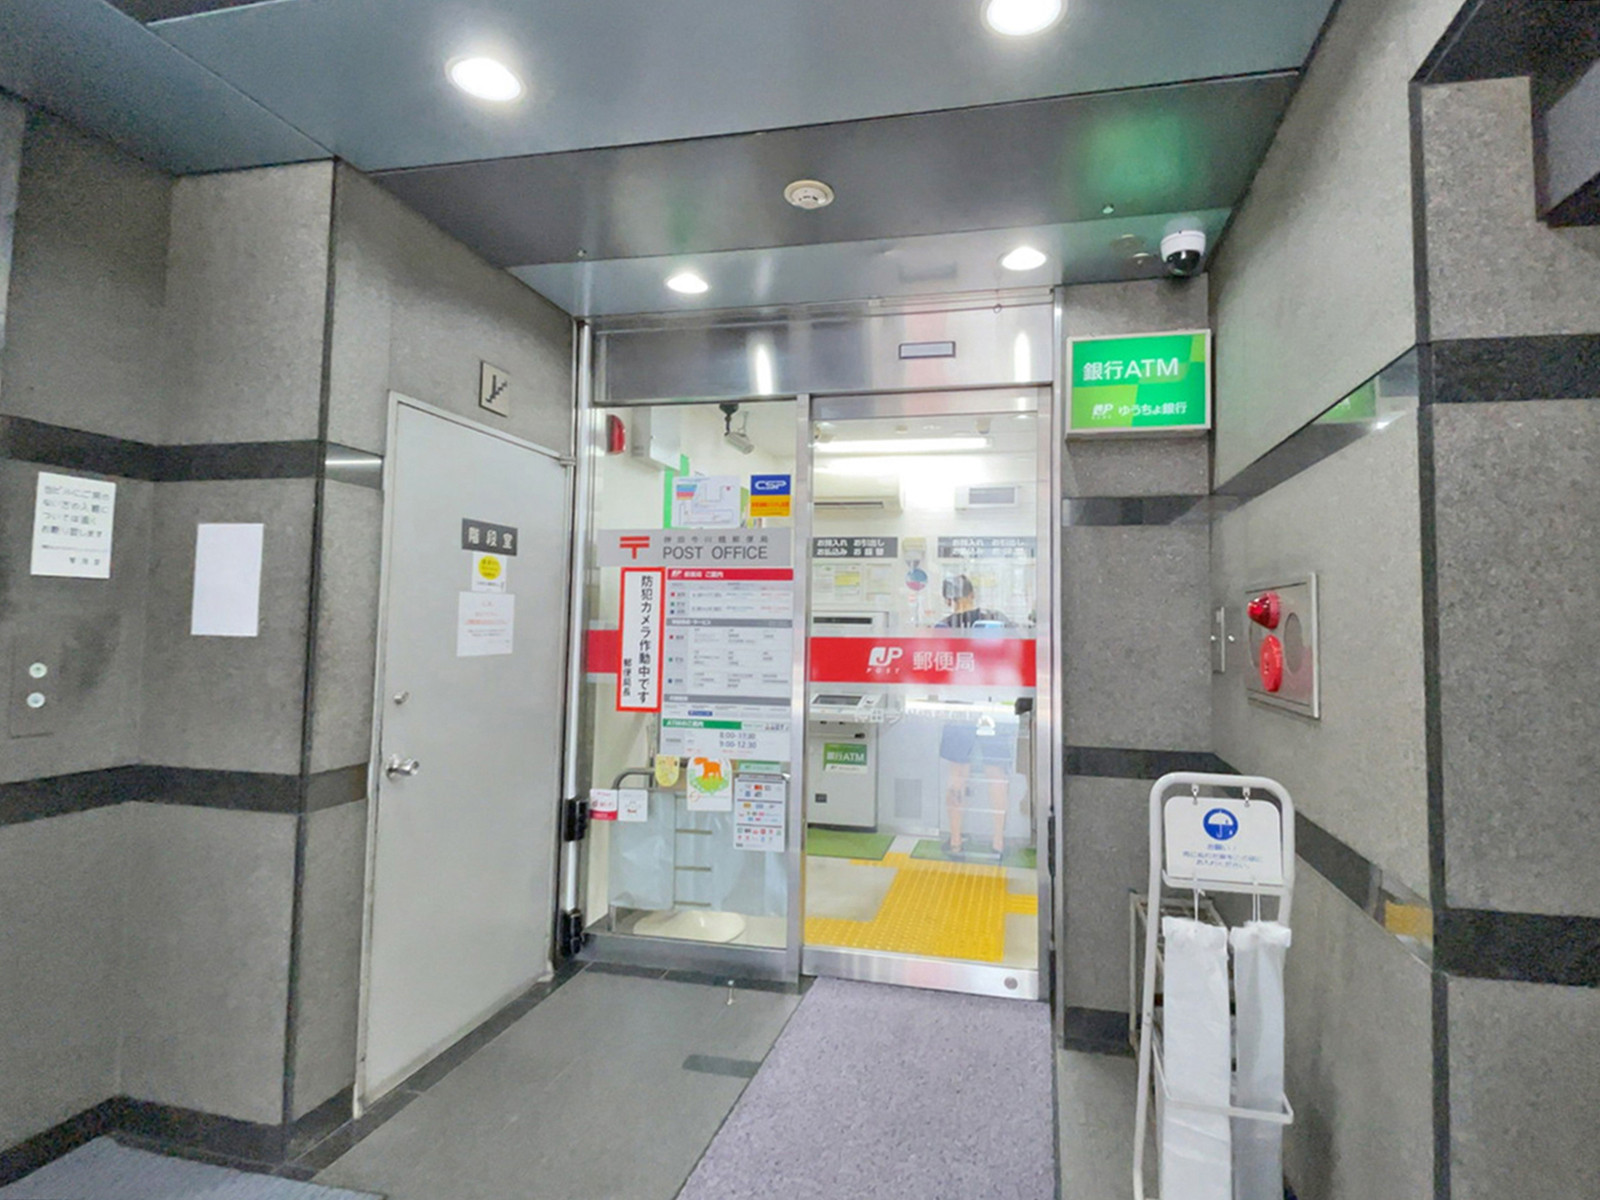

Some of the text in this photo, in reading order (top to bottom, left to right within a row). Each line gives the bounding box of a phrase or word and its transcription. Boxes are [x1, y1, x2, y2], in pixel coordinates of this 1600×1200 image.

[1082, 357, 1179, 381] 銀行ATM
[1118, 401, 1188, 416] ゆうちょ銀行
[754, 480, 787, 490] CSP
[467, 526, 513, 549] 階段室
[662, 546, 768, 560] POST OFFICE
[637, 575, 653, 703] 防犯カメラ作動中です
[868, 646, 975, 673] JP 郵便局
[622, 658, 633, 697] 郵便局長
